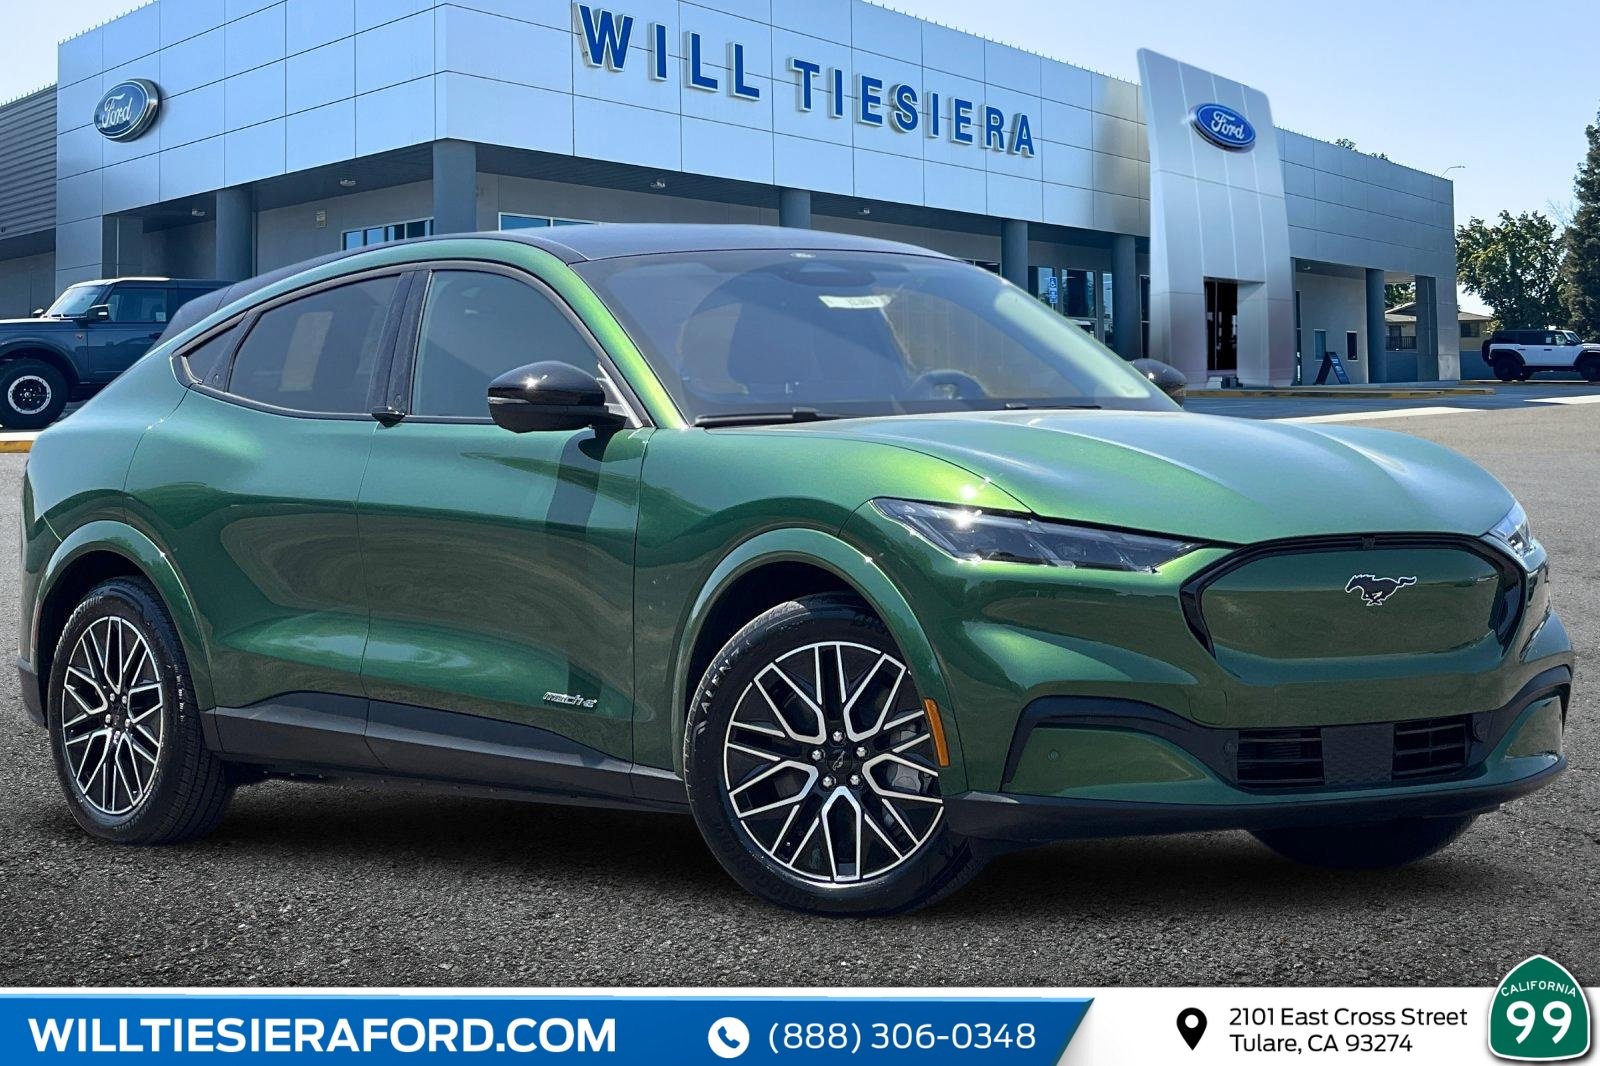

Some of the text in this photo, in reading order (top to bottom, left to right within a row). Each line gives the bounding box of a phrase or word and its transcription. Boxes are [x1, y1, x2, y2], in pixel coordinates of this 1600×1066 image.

[575, 3, 1035, 157] WILL TIESIERA
[101, 93, 133, 129] Ford
[1211, 110, 1245, 140] Ford
